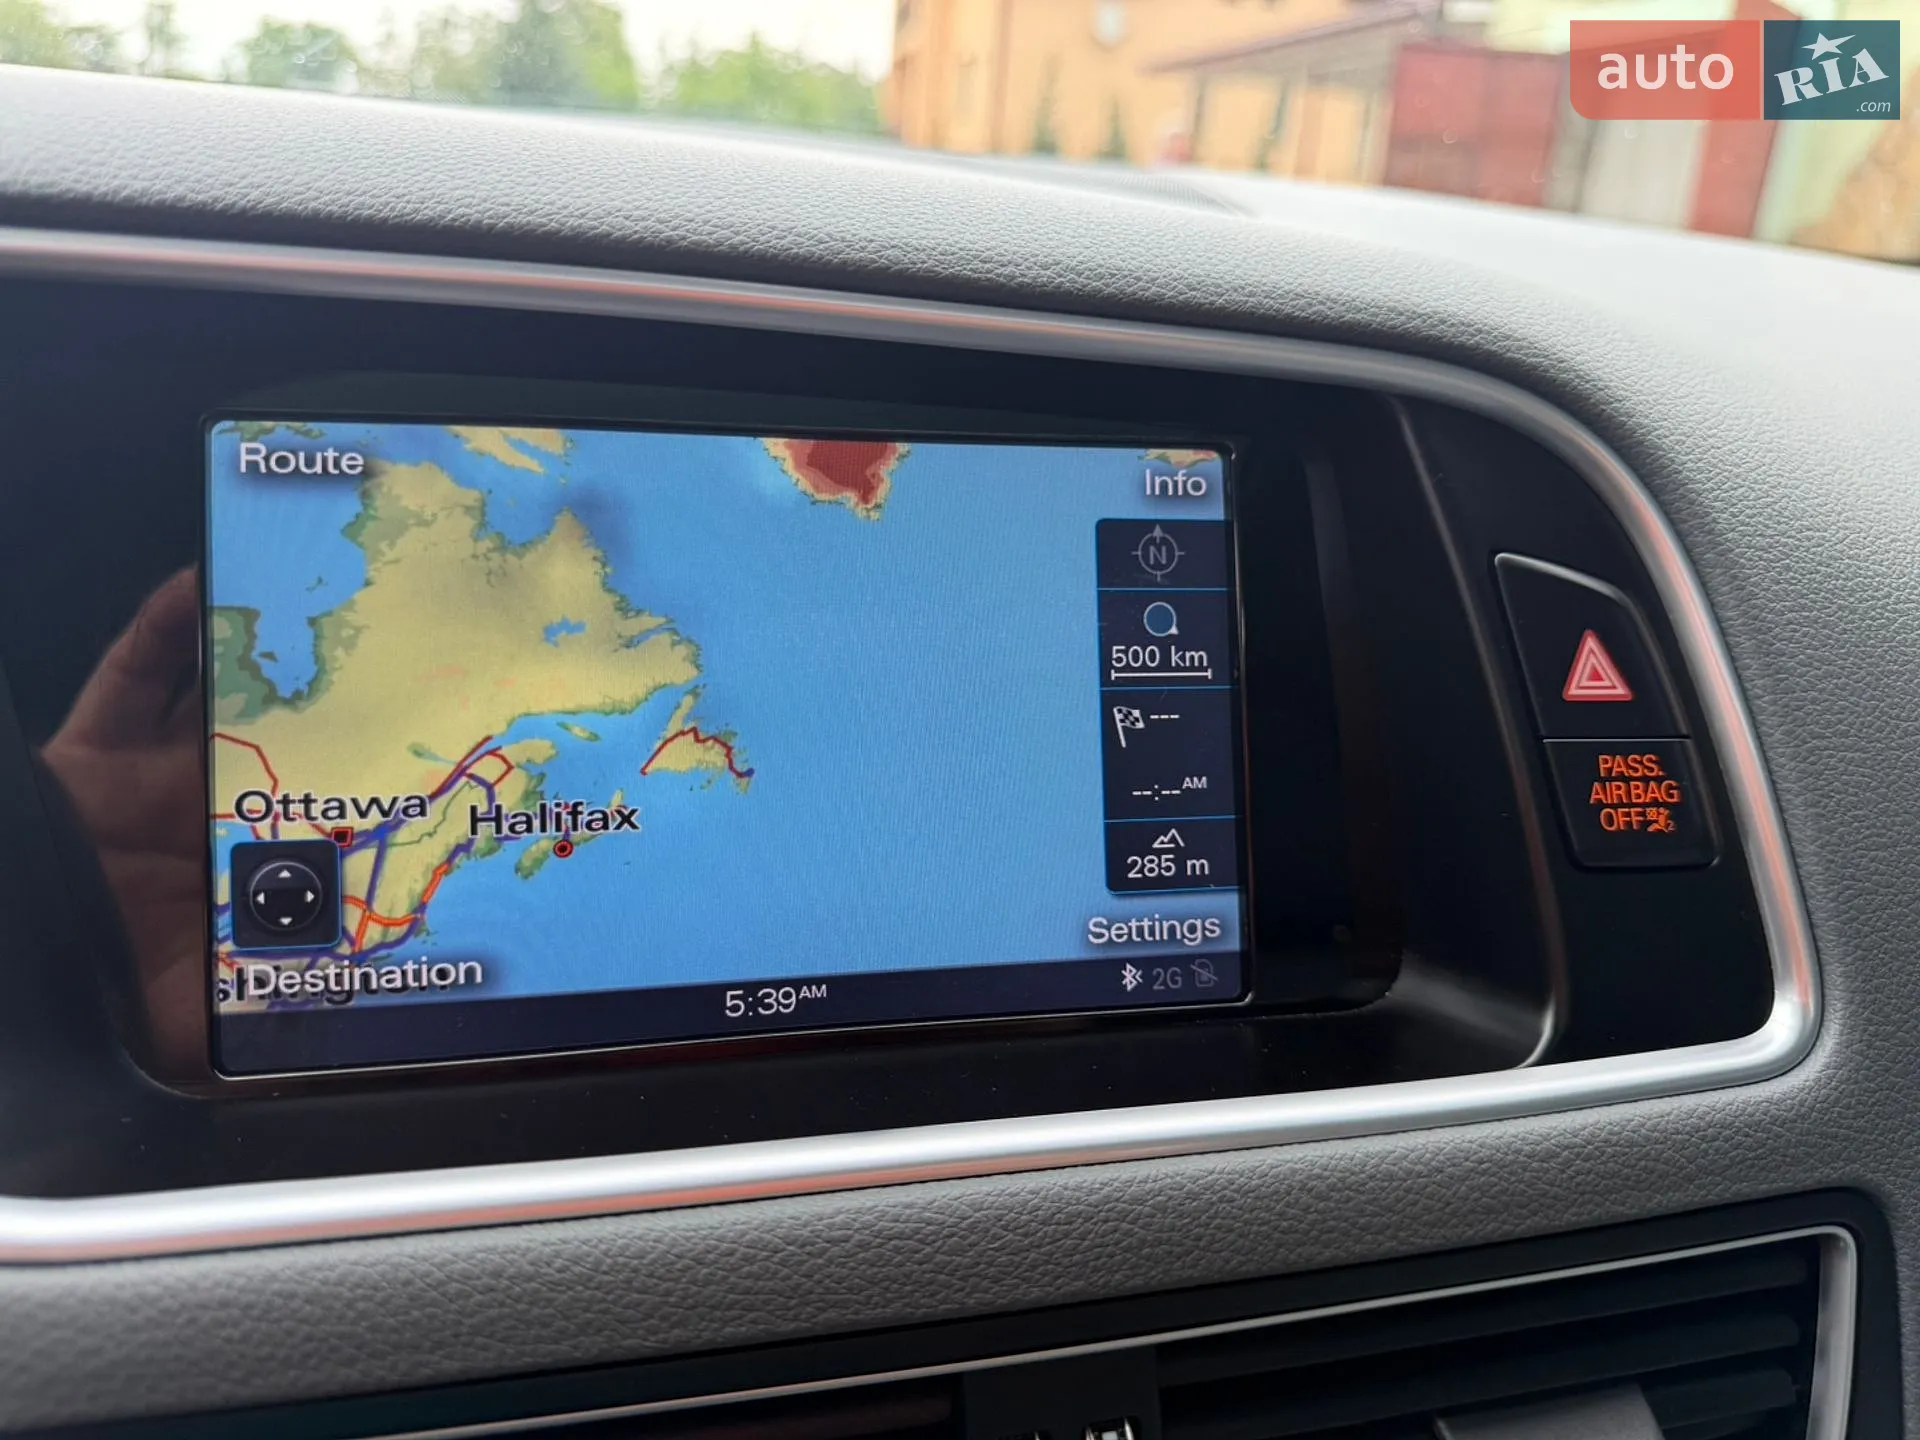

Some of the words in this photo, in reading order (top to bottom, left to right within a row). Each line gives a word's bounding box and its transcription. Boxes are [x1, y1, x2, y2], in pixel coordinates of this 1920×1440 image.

[239, 442, 365, 476] Route
[1145, 468, 1208, 497] Info
[1149, 545, 1168, 565] N
[1111, 645, 1161, 668] 500
[1170, 645, 1208, 668] km
[1598, 754, 1666, 778] PASS.
[1590, 780, 1680, 804] AIRBAG
[234, 790, 429, 823] Ottawa
[469, 801, 640, 838] Halifax
[1600, 807, 1645, 832] OFF
[1126, 854, 1176, 879] 285
[1186, 857, 1210, 876] m
[1087, 913, 1221, 946] Settings
[247, 955, 483, 996] Destination
[1152, 967, 1183, 990] 2G
